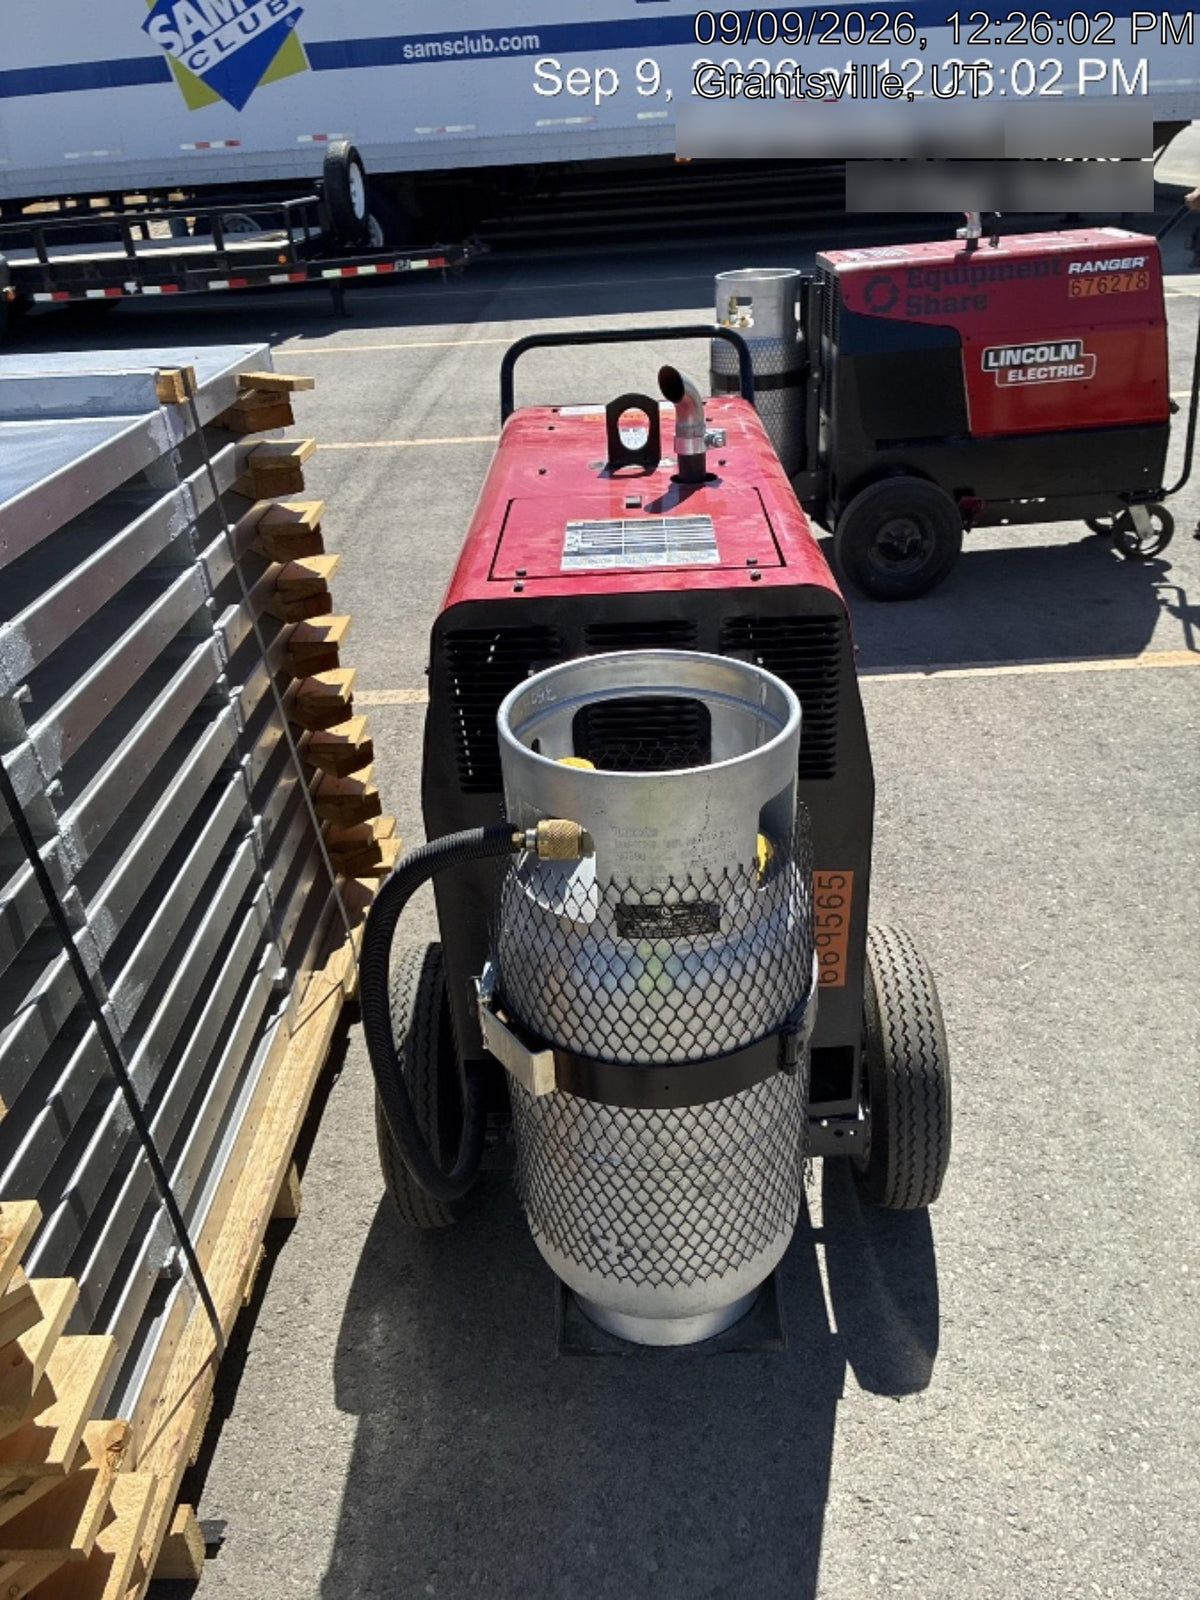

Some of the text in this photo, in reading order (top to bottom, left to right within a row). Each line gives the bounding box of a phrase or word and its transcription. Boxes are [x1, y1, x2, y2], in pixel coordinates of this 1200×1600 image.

[188, 0, 289, 70] CLUB
[403, 35, 540, 58] samsclub.com
[907, 259, 1062, 291] Equipment
[1068, 256, 1146, 274] RANGER
[1071, 273, 1148, 296] 676278
[906, 293, 988, 316] Share
[988, 344, 1077, 368] LINCOLN
[1007, 364, 1085, 383] ELECTRIC
[816, 874, 846, 984] 669565
